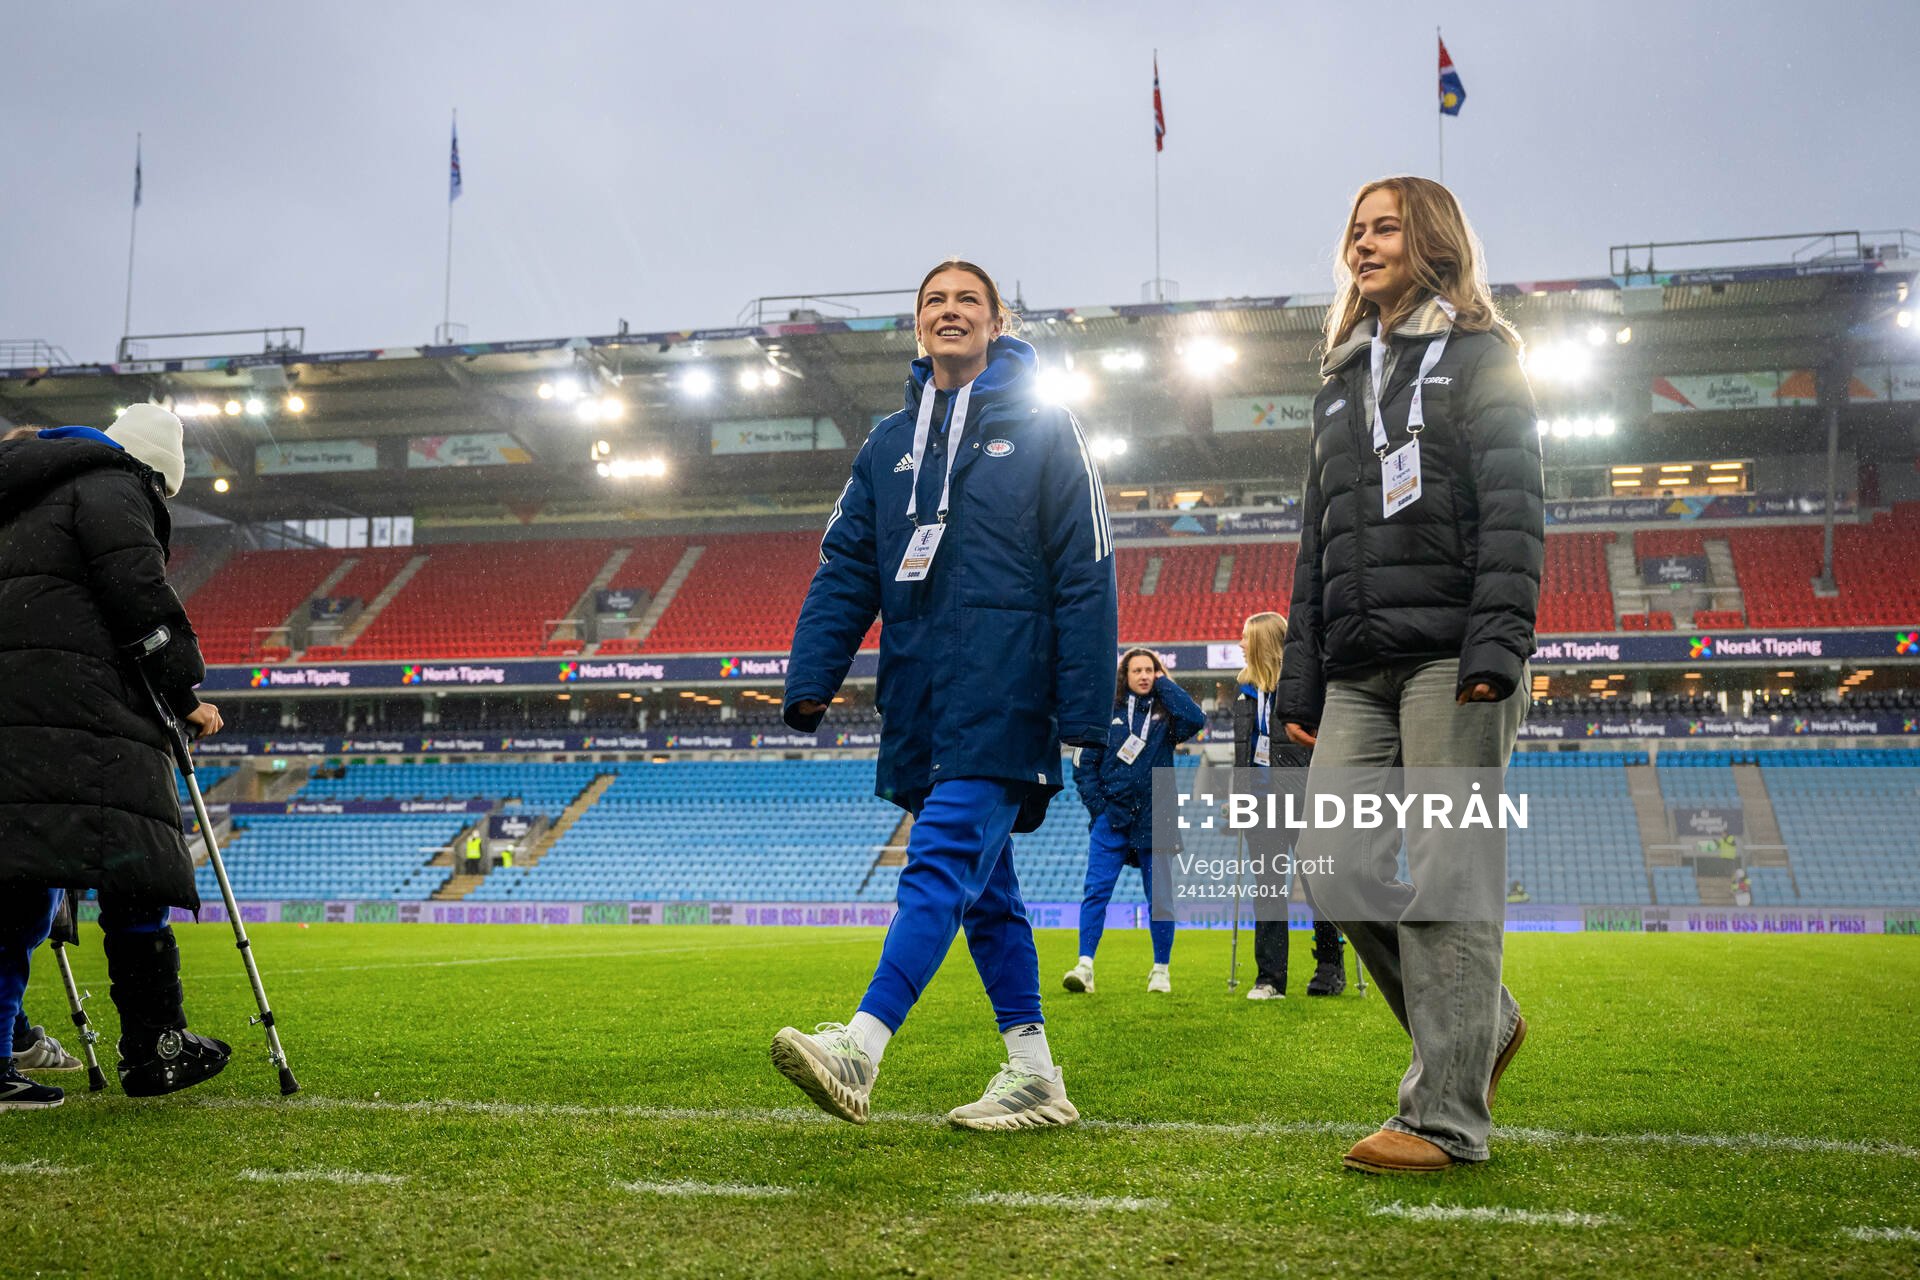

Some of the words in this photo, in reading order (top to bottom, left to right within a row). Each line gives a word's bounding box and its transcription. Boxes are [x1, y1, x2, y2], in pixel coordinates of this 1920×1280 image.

[1281, 406, 1312, 421] Nor
[893, 462, 914, 473] adida
[1531, 643, 1562, 658] orsk
[1563, 641, 1620, 660] Tipping
[1716, 639, 1761, 655] Norsk
[1763, 638, 1822, 656] Tipping
[579, 664, 616, 678] Norsk
[617, 662, 664, 680] Tipping
[742, 659, 780, 674] Norsk
[270, 671, 304, 684] Norsk
[306, 669, 351, 686] Tipping
[422, 667, 458, 681] Norsk
[460, 666, 505, 683] Tipping
[1529, 726, 1564, 737] Tipping
[1602, 725, 1629, 735] Norsk
[1630, 723, 1666, 735] Tipping
[1705, 722, 1732, 732] Norsk
[1733, 721, 1770, 733] Tipping
[1811, 721, 1840, 731] Norsk
[1841, 720, 1878, 733] Tipping
[354, 742, 375, 750] Norsk
[376, 741, 404, 751] Tipping
[433, 740, 455, 749] Norsk
[456, 740, 484, 750] Tipping
[514, 740, 536, 748] Norsk
[537, 739, 565, 750] Tipping
[596, 738, 618, 747] Norsk
[619, 737, 648, 748] Tipping
[679, 737, 702, 746] Norsk
[703, 736, 732, 748] Tipping
[763, 736, 786, 745] Norsk
[787, 735, 818, 747] Tipping
[1585, 908, 1642, 932] KIWI
[1687, 913, 1701, 931] VI
[1705, 913, 1728, 931] GIR
[1732, 913, 1758, 932] OSS
[1762, 913, 1803, 932] ALDRI
[1807, 909, 1824, 932] PÅ
[1829, 914, 1866, 933] PRIS!
